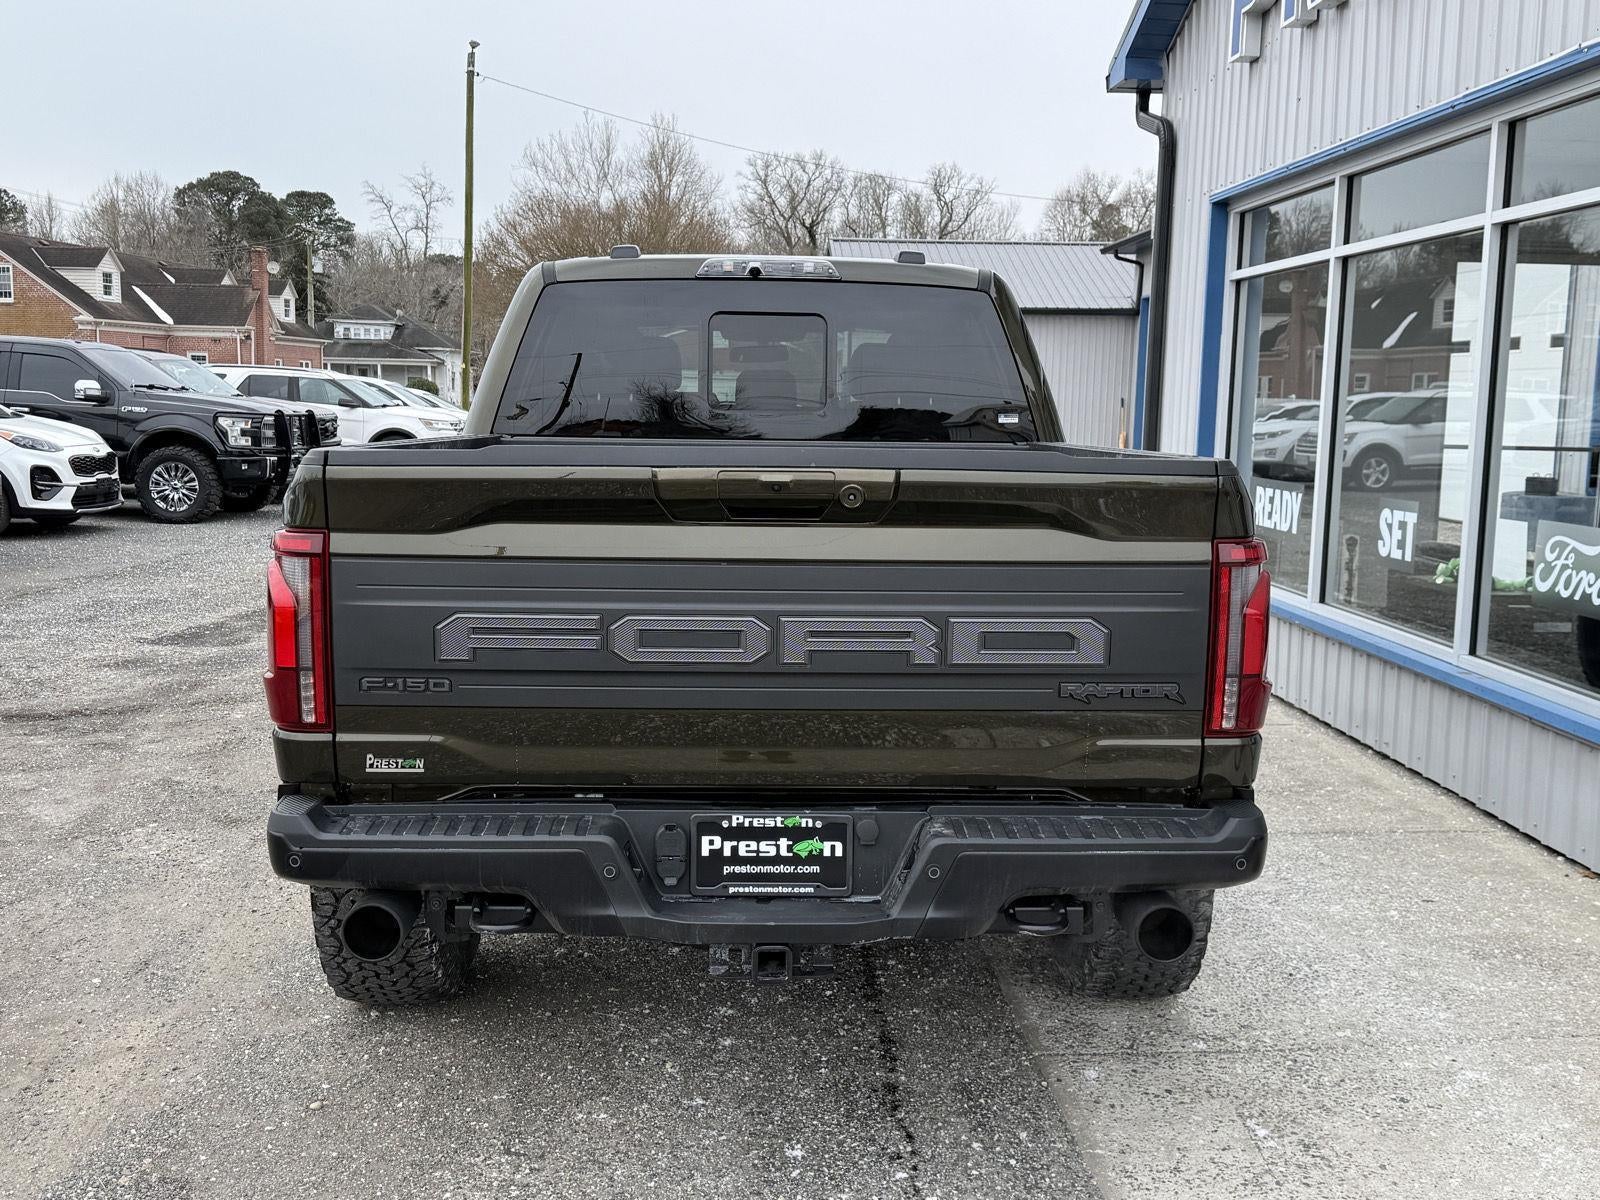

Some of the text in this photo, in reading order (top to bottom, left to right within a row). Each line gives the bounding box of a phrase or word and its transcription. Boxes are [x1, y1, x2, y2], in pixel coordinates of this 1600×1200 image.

[1255, 485, 1302, 535] READY
[1377, 507, 1417, 562] SET
[435, 612, 1109, 667] FORD
[359, 676, 452, 692] F-150
[1058, 681, 1186, 704] RAPTOR
[723, 864, 820, 875] prestonmotor.com
